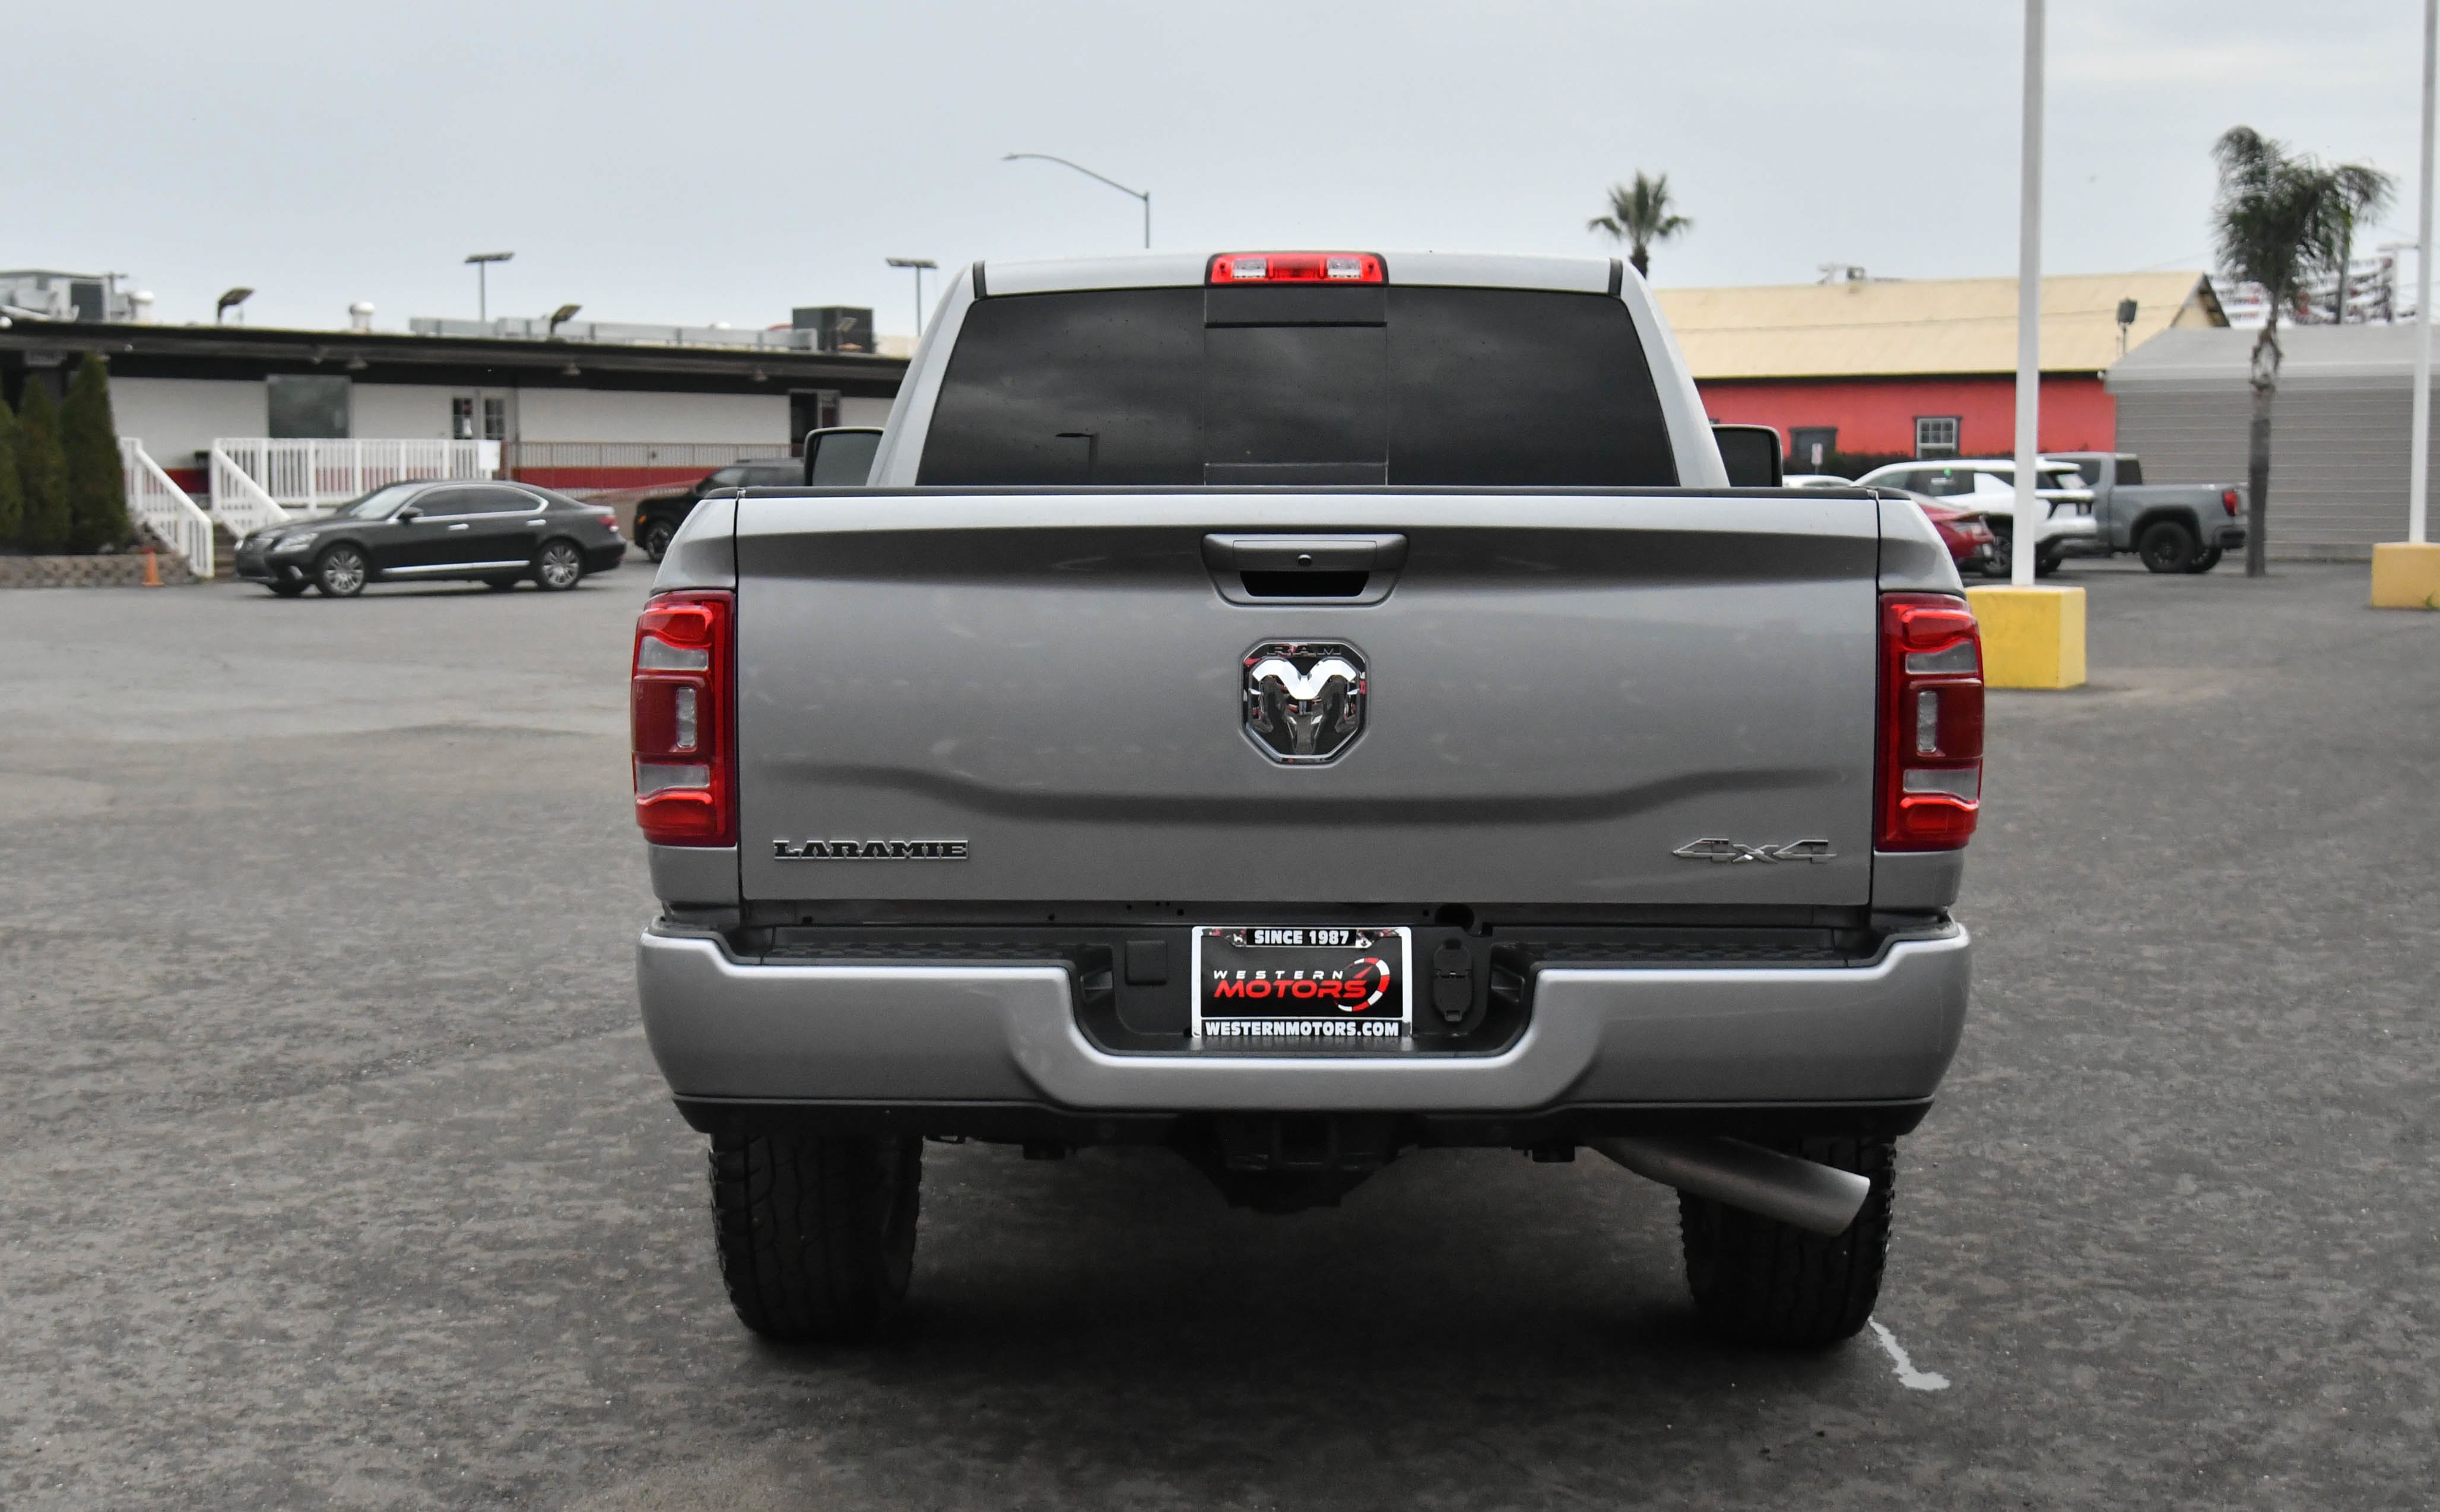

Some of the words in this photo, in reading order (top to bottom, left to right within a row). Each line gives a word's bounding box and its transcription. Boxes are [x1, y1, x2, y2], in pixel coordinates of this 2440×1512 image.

[1267, 645, 1341, 656] RAM
[773, 840, 968, 859] LARAMIE
[1255, 930, 1303, 944] SINCE
[1309, 931, 1349, 945] 1987
[1214, 970, 1344, 980] WESTERN
[1214, 980, 1367, 998] MOTORS
[1205, 1021, 1399, 1037] WESTERNMOTORS.COM
